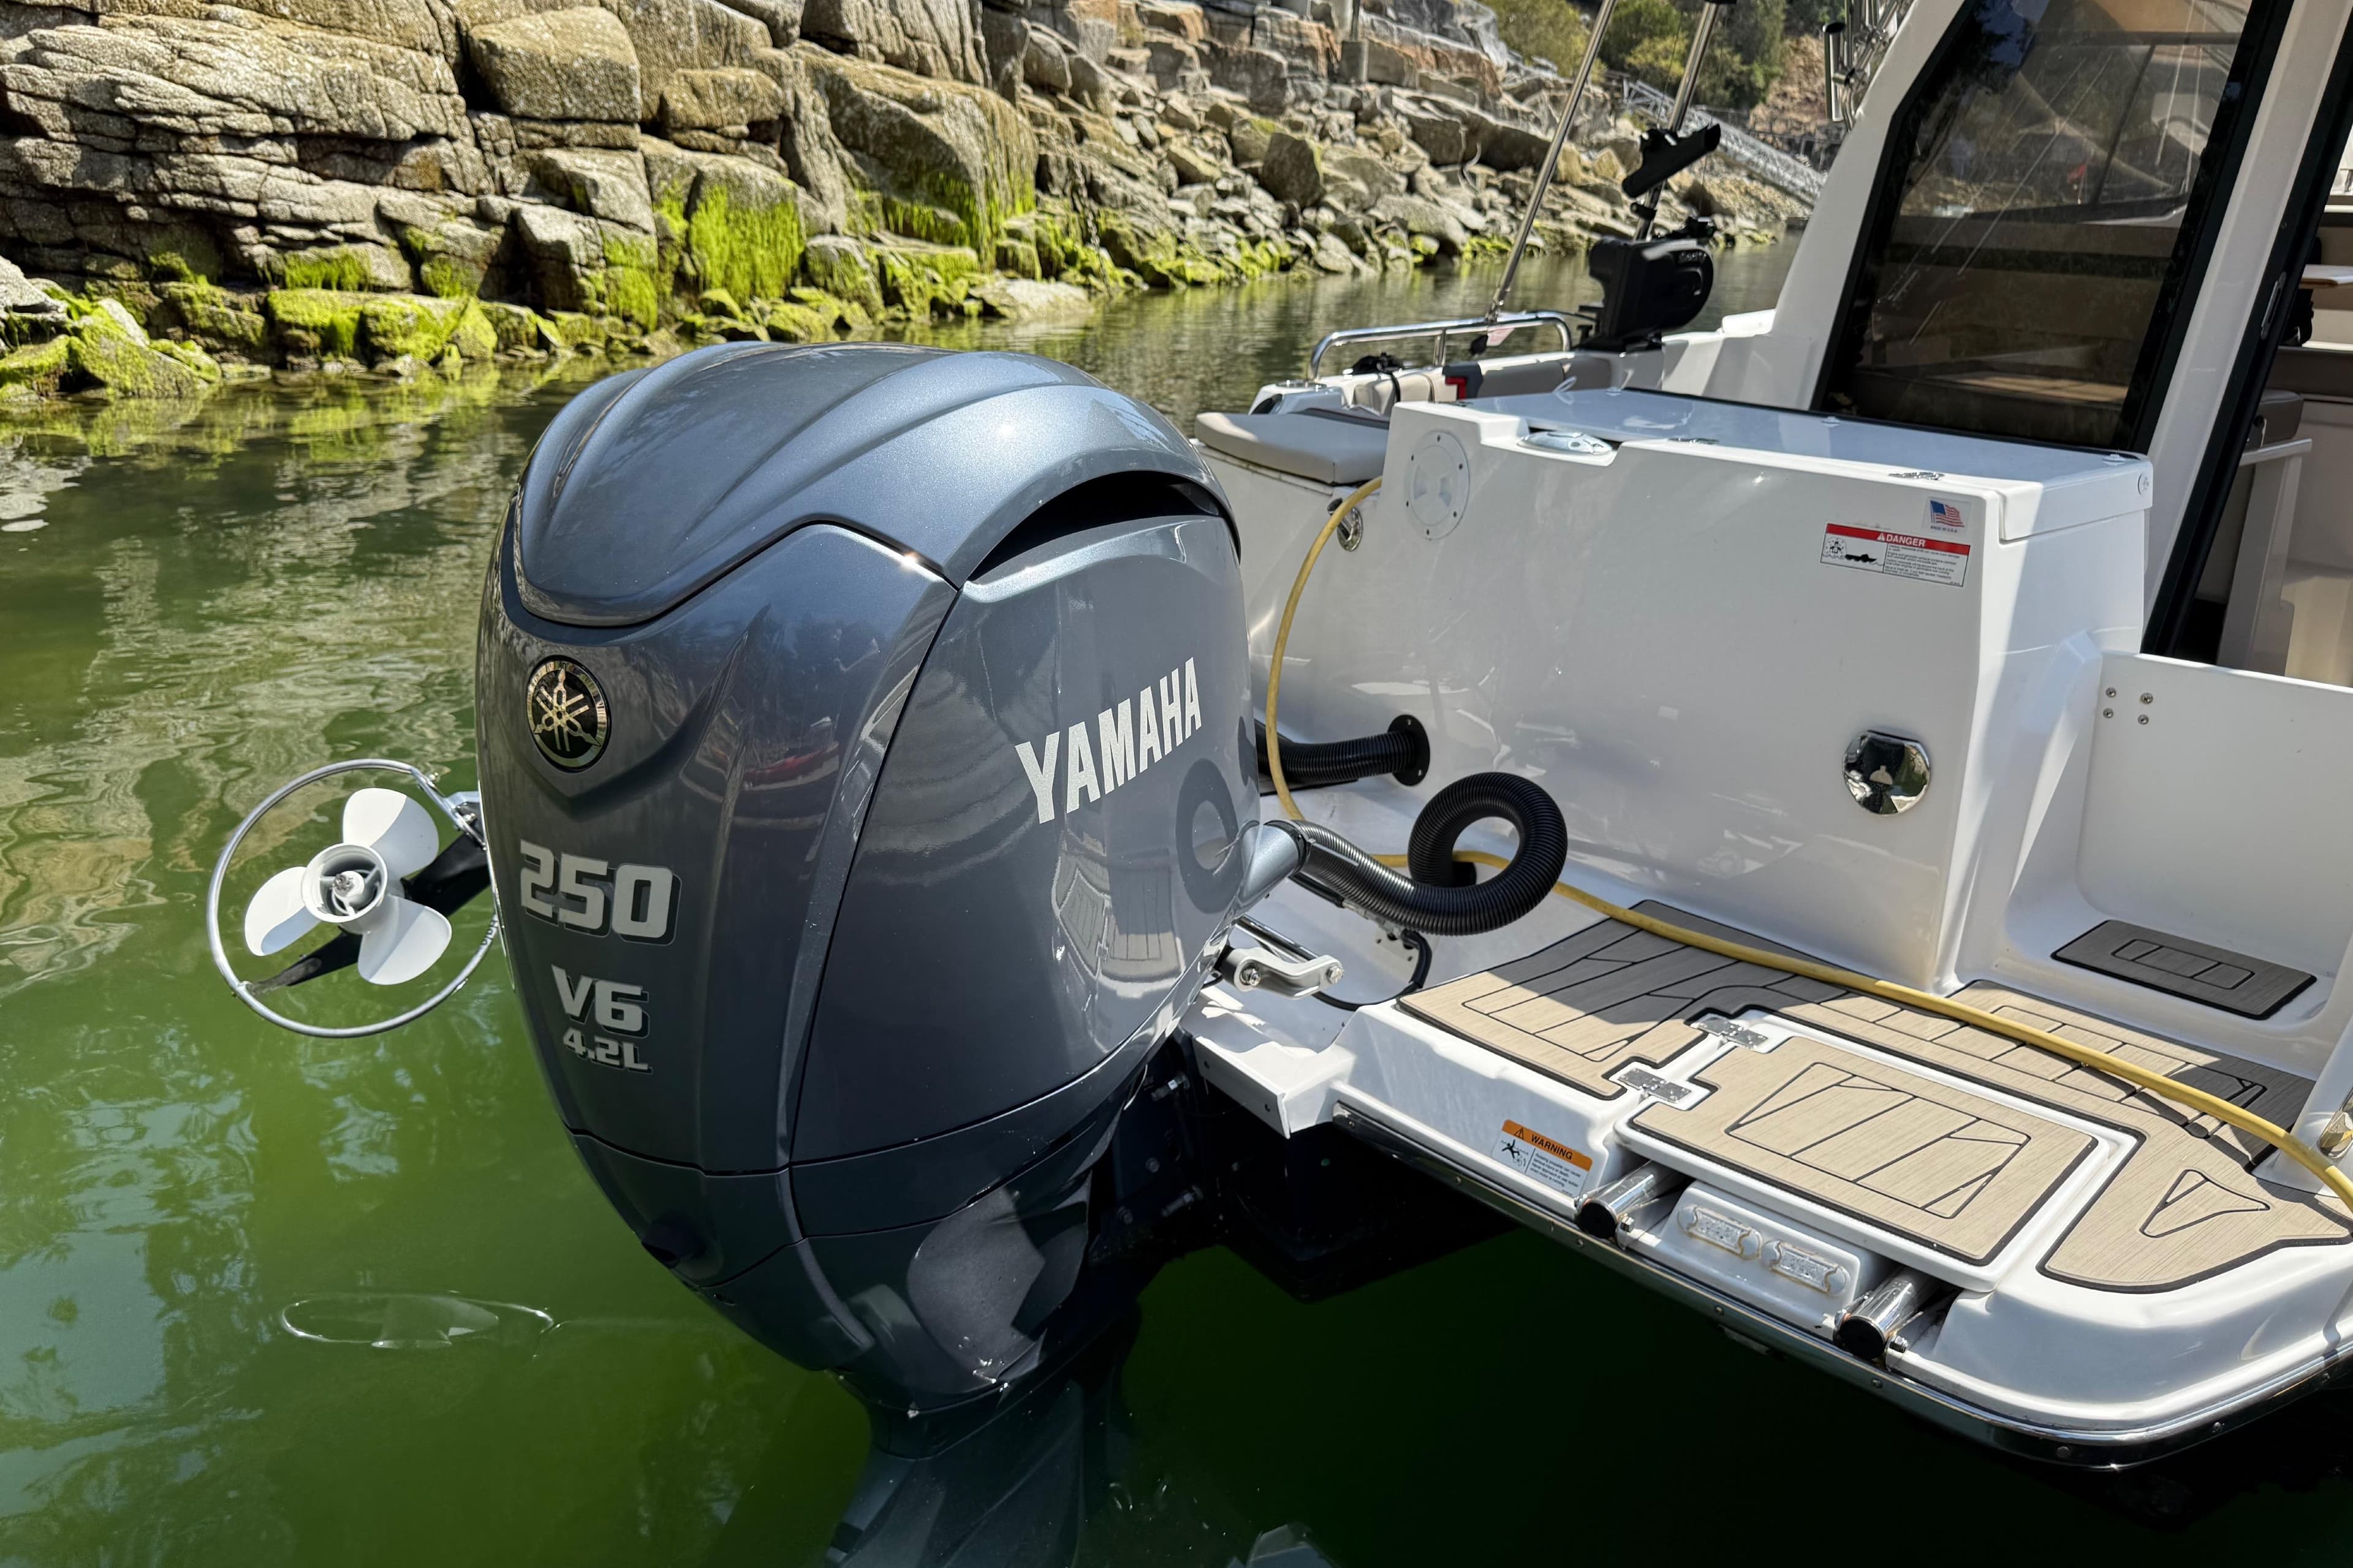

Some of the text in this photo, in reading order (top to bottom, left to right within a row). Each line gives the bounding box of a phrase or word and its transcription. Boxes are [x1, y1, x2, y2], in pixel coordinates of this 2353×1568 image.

[1886, 534, 1925, 547] DANGER
[1015, 657, 1202, 824] YAMAHA
[520, 839, 676, 941] 250
[551, 964, 646, 1034] V6
[563, 1026, 650, 1072] 4.2L
[1531, 1134, 1573, 1160] WARNING
